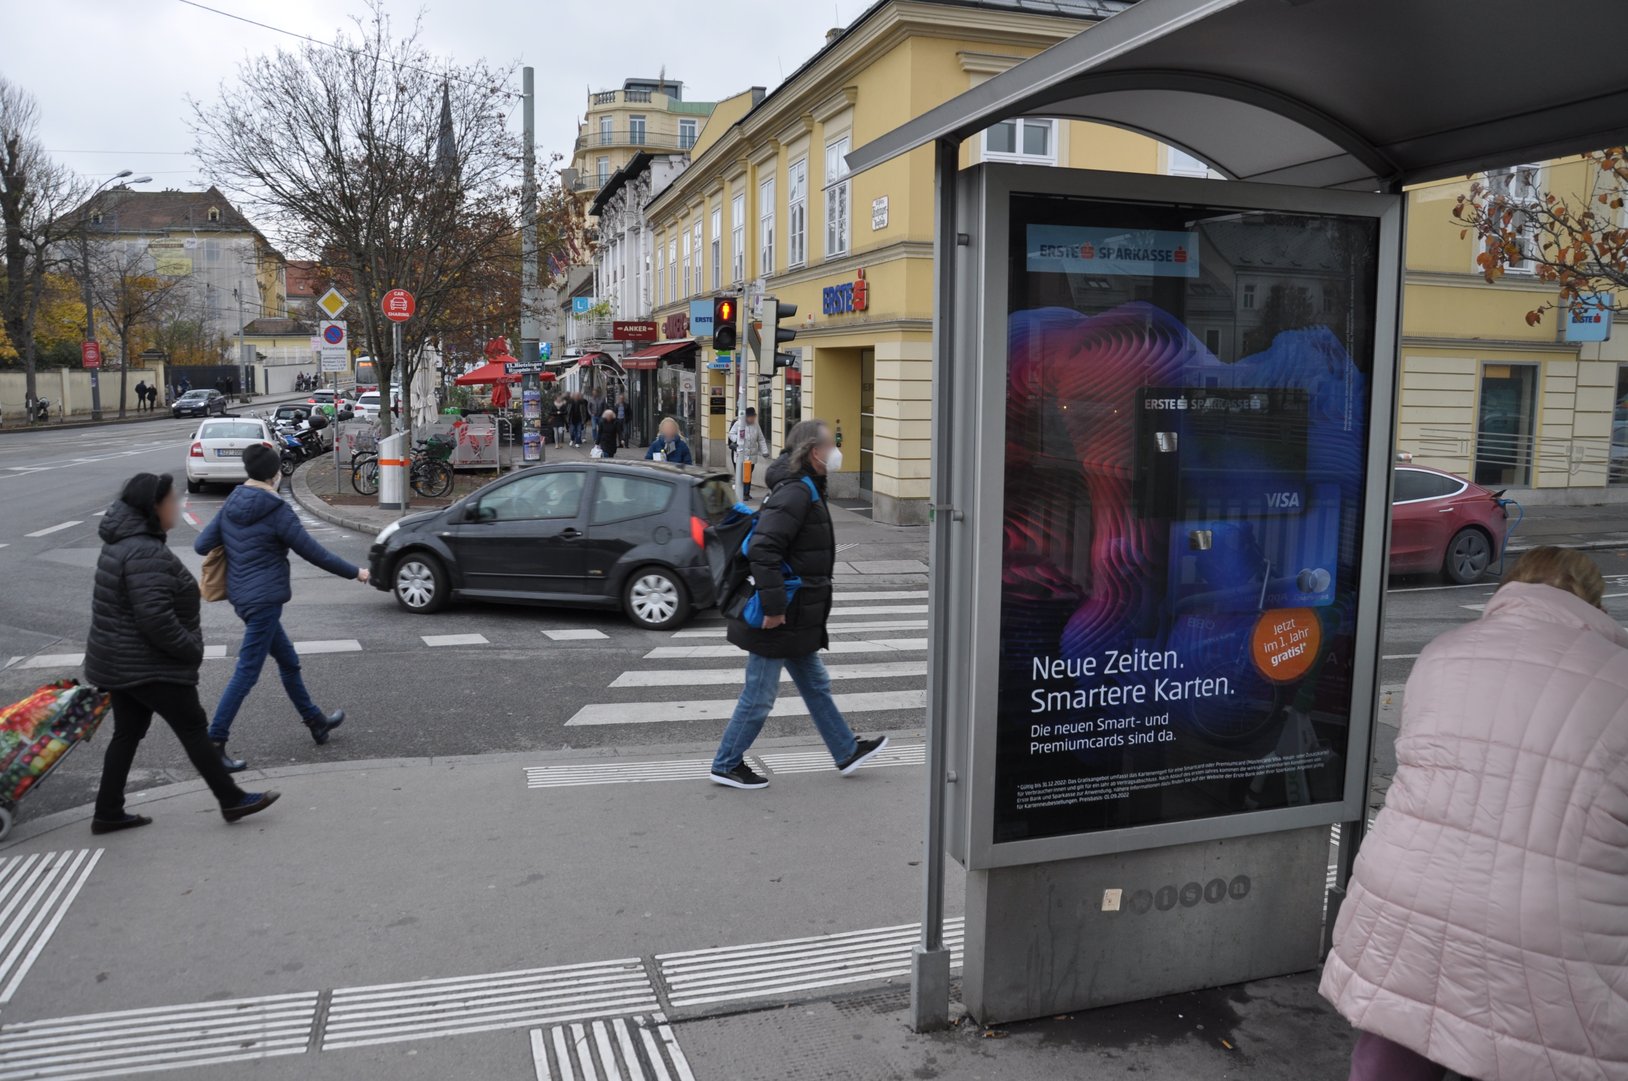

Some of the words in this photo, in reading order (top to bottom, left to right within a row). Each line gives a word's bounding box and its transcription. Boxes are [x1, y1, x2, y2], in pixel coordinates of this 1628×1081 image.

[1040, 244, 1079, 259] ERSTE
[1098, 247, 1173, 263] SPARKASSE
[822, 281, 853, 315] ERSTE
[1144, 398, 1176, 410] ERSTE
[1191, 398, 1249, 411] SPARKASSE
[1264, 492, 1300, 508] VISA
[1273, 617, 1296, 636] Jetzt
[1263, 640, 1279, 653] im
[1280, 636, 1289, 649] 1.
[1289, 627, 1310, 646] Jahr
[1032, 655, 1097, 681] Neue
[1104, 647, 1185, 675] Zeiten.
[1030, 684, 1145, 714] Smartere
[1154, 676, 1235, 702] Karten.
[1031, 723, 1052, 738] Die
[1054, 720, 1093, 735] neuen
[1097, 716, 1141, 731] Smart-
[1145, 713, 1169, 726] und
[1030, 733, 1124, 755] Premiumcards
[1128, 730, 1154, 745] sind
[1157, 728, 1177, 743] da.
